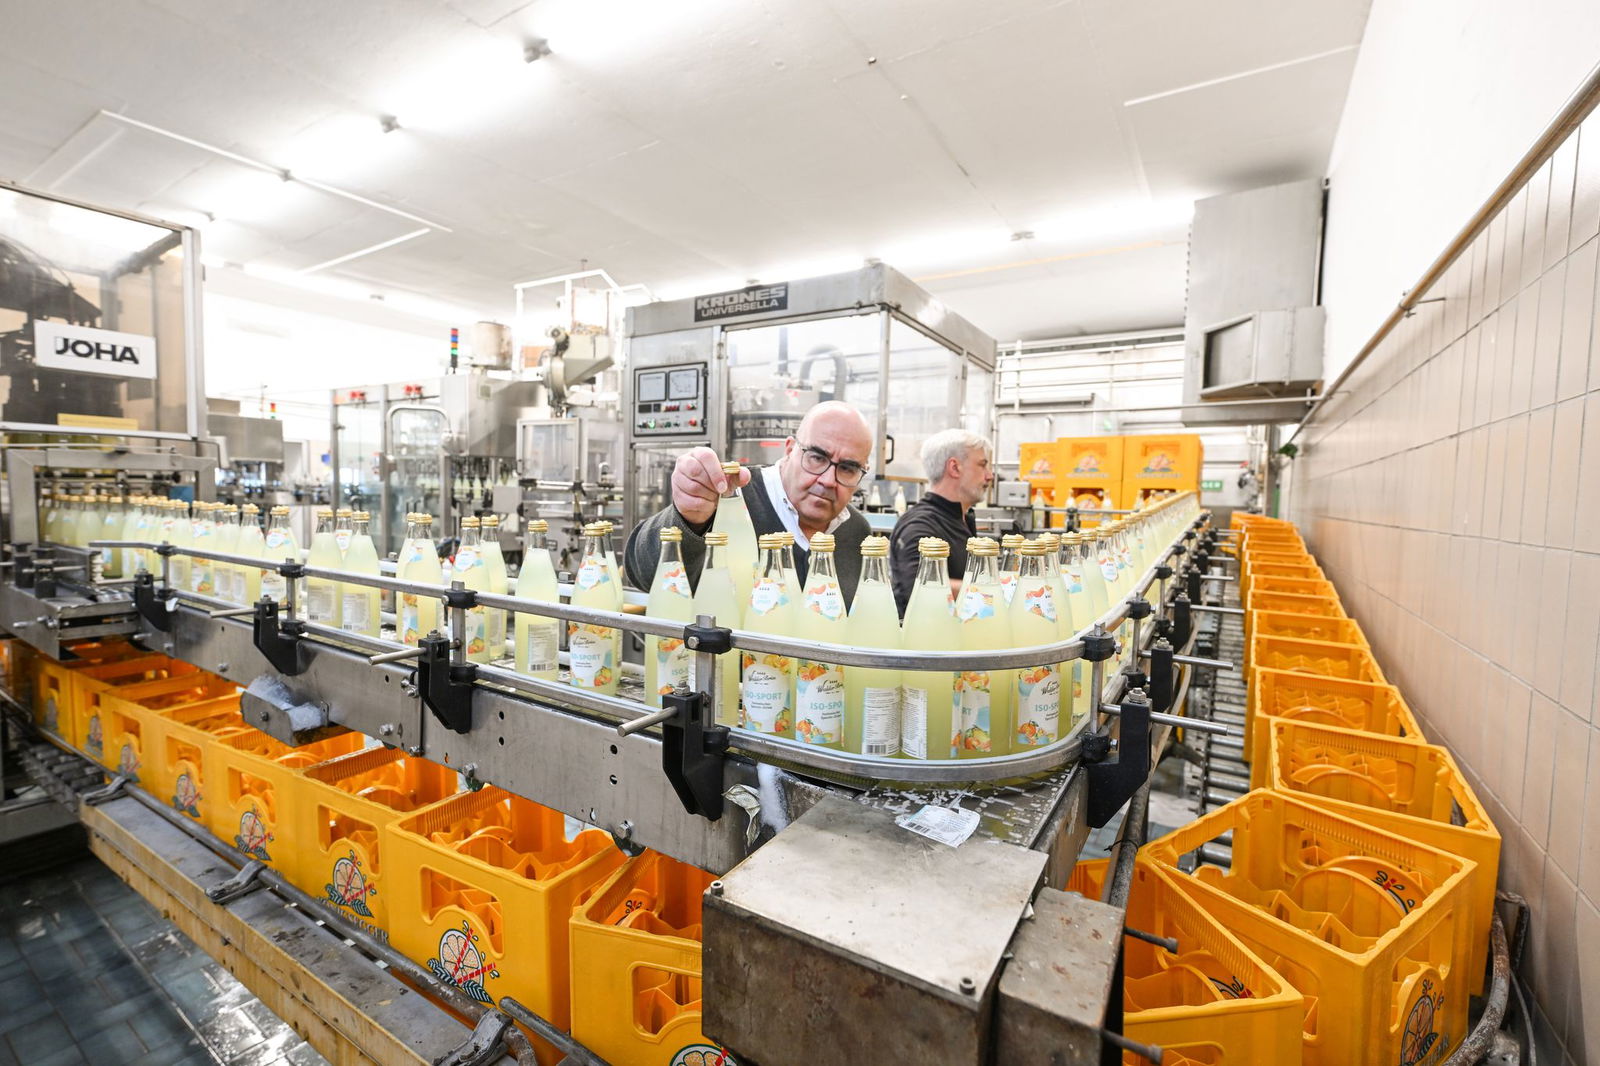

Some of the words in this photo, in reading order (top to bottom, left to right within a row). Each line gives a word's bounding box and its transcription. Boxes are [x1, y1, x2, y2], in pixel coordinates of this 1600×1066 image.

[696, 286, 786, 310] KRONES
[701, 299, 779, 317] UNIVERSELLA
[55, 337, 139, 365] JOHA
